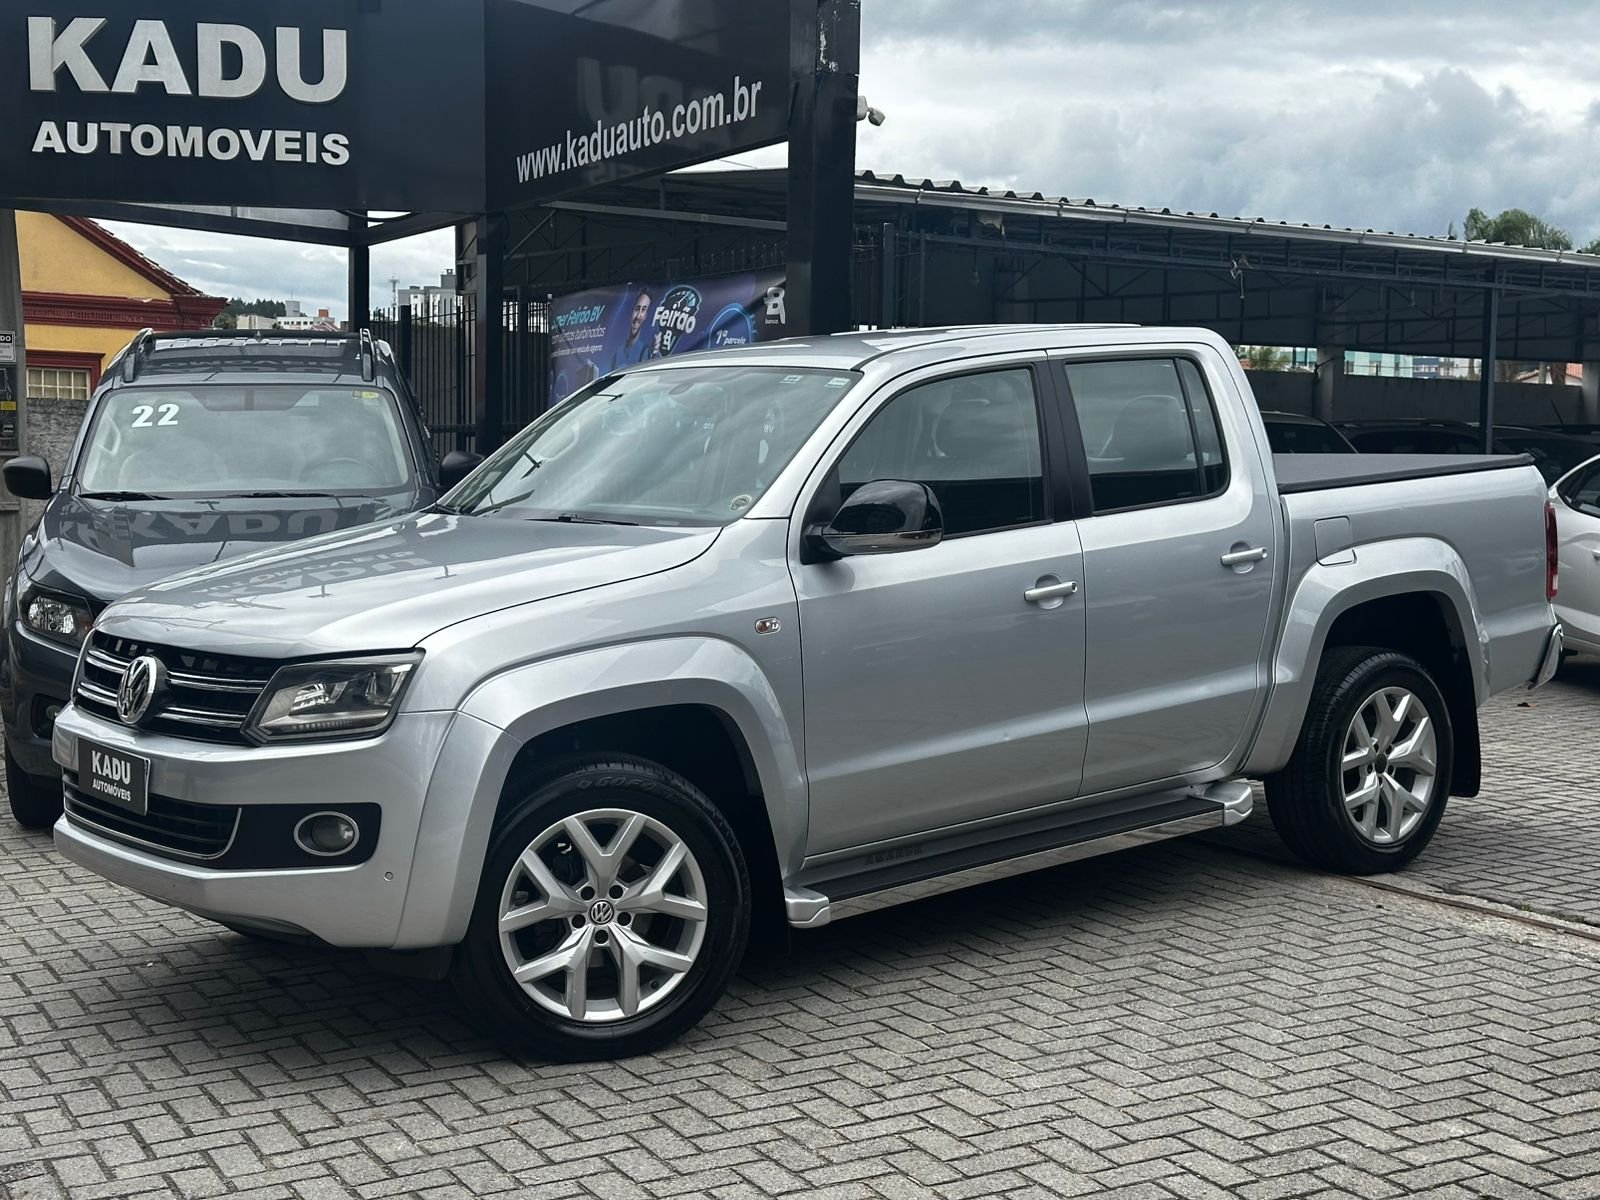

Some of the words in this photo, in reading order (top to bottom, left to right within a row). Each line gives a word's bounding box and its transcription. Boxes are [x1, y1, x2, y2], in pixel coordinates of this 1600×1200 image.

[27, 16, 348, 103] KADU
[32, 121, 350, 165] AUTOMOVEIS
[516, 75, 762, 183] www.kaduauto.com.br
[651, 303, 696, 334] Feirão
[723, 335, 746, 346] parcela
[131, 403, 180, 428] 22
[91, 750, 131, 785] KADU
[92, 778, 131, 802] AUTOMÓVEIS
